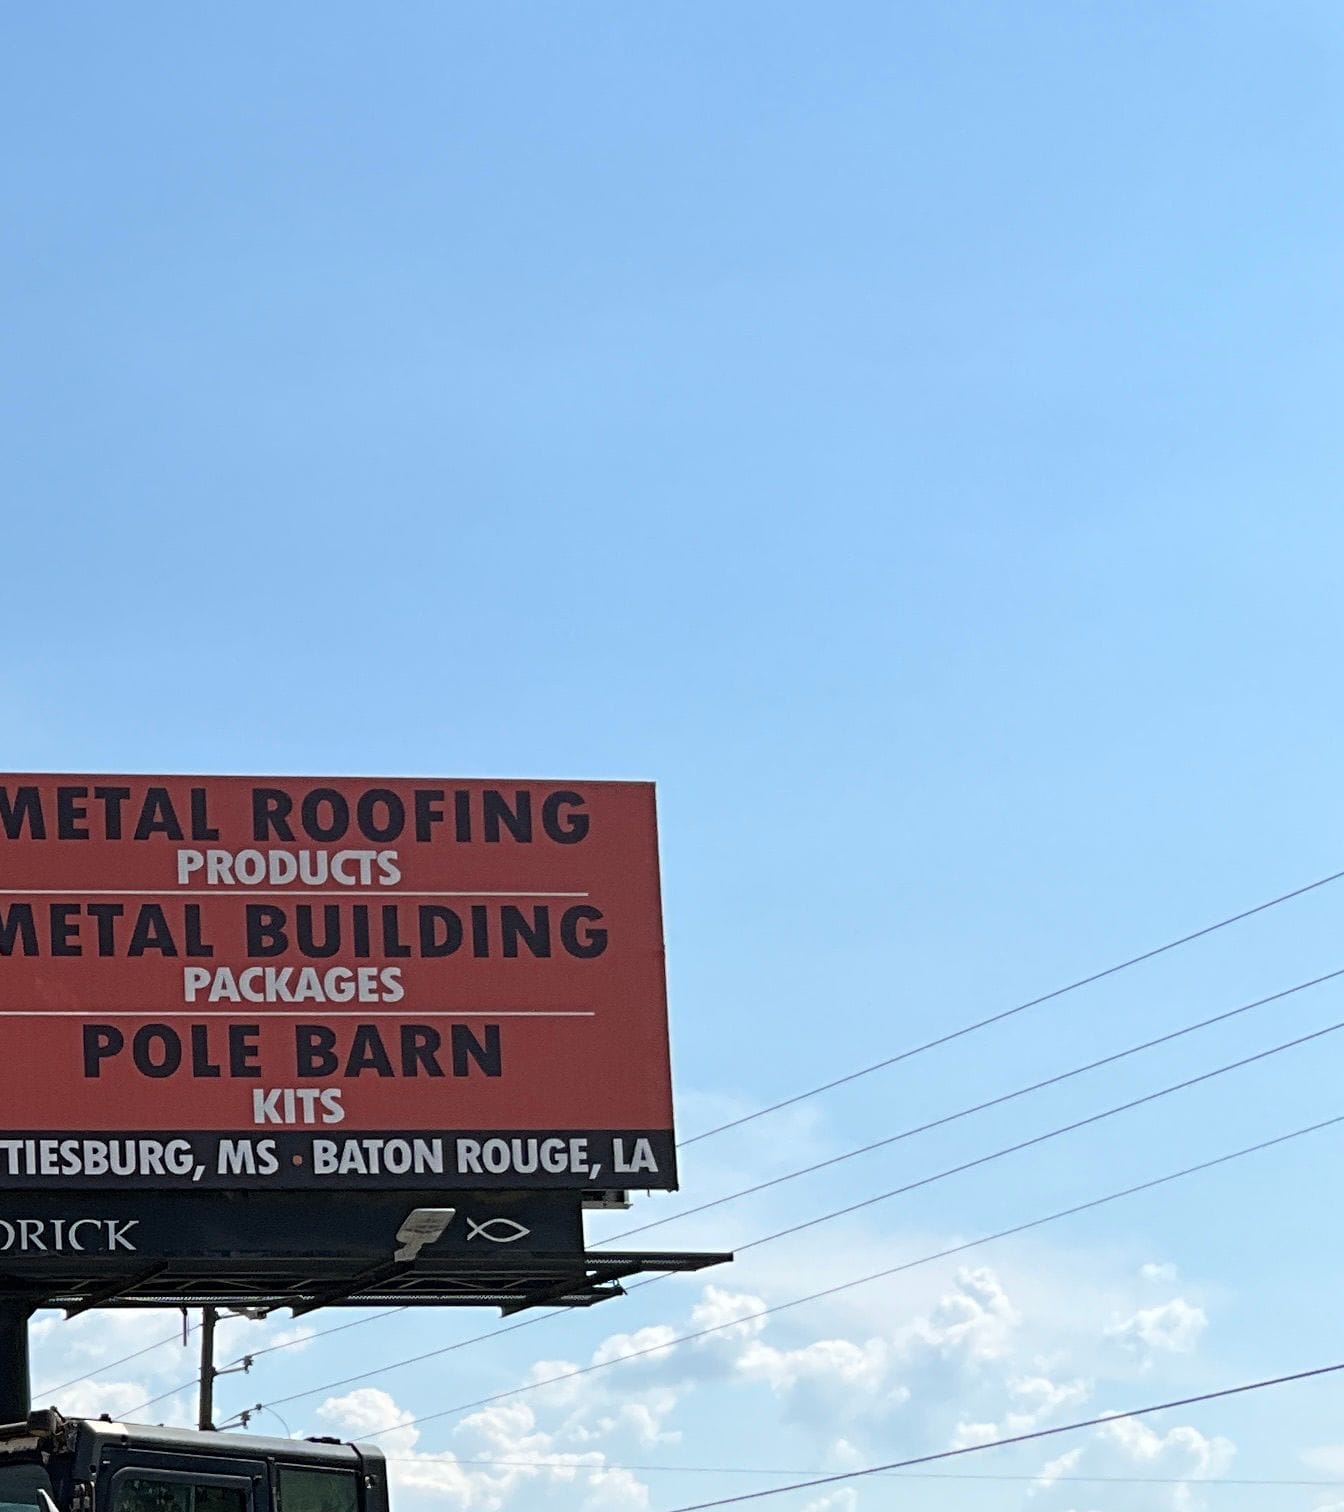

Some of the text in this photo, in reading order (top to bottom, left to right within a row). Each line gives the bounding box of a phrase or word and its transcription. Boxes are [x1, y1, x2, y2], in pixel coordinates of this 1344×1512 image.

[251, 786, 591, 845] ROOFING
[177, 849, 402, 886] PRODUCTS
[245, 903, 609, 960] BUILDING
[183, 966, 405, 1003] PACKAGES
[82, 1023, 503, 1079] POLE BARN
[252, 1087, 345, 1124] KITS
[217, 1139, 279, 1175] MS
[312, 1138, 444, 1175] BATON
[456, 1138, 602, 1180] ROUGE,
[612, 1137, 659, 1173] LA
